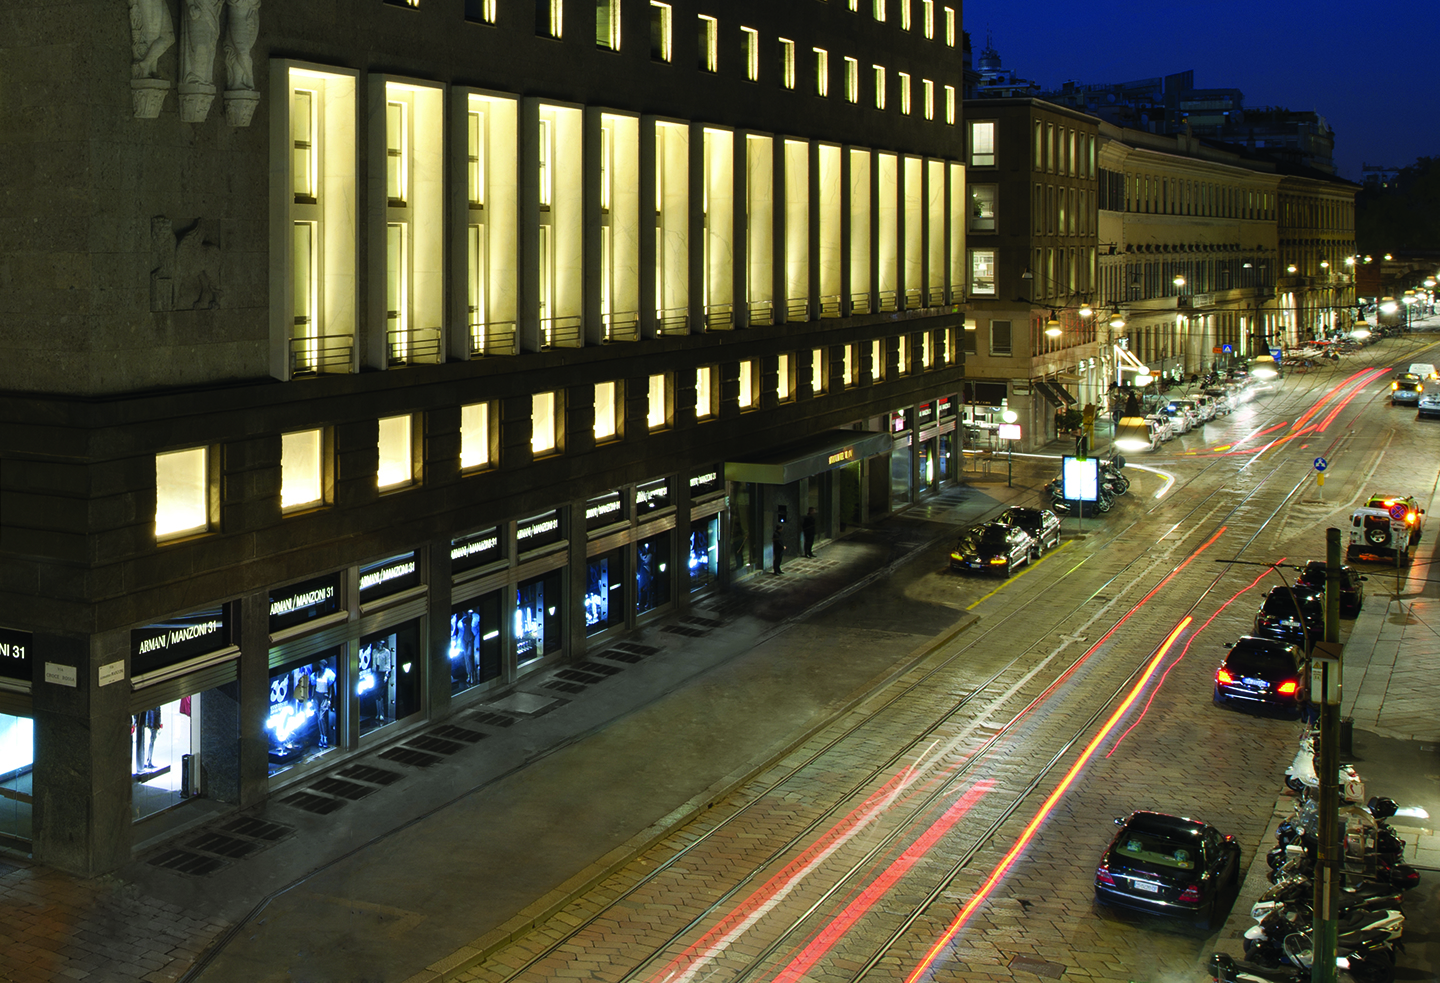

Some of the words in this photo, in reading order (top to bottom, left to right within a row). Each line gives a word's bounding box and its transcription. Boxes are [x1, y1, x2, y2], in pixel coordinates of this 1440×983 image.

[326, 586, 334, 598] 31
[207, 620, 217, 634] 31
[12, 645, 25, 659] 31
